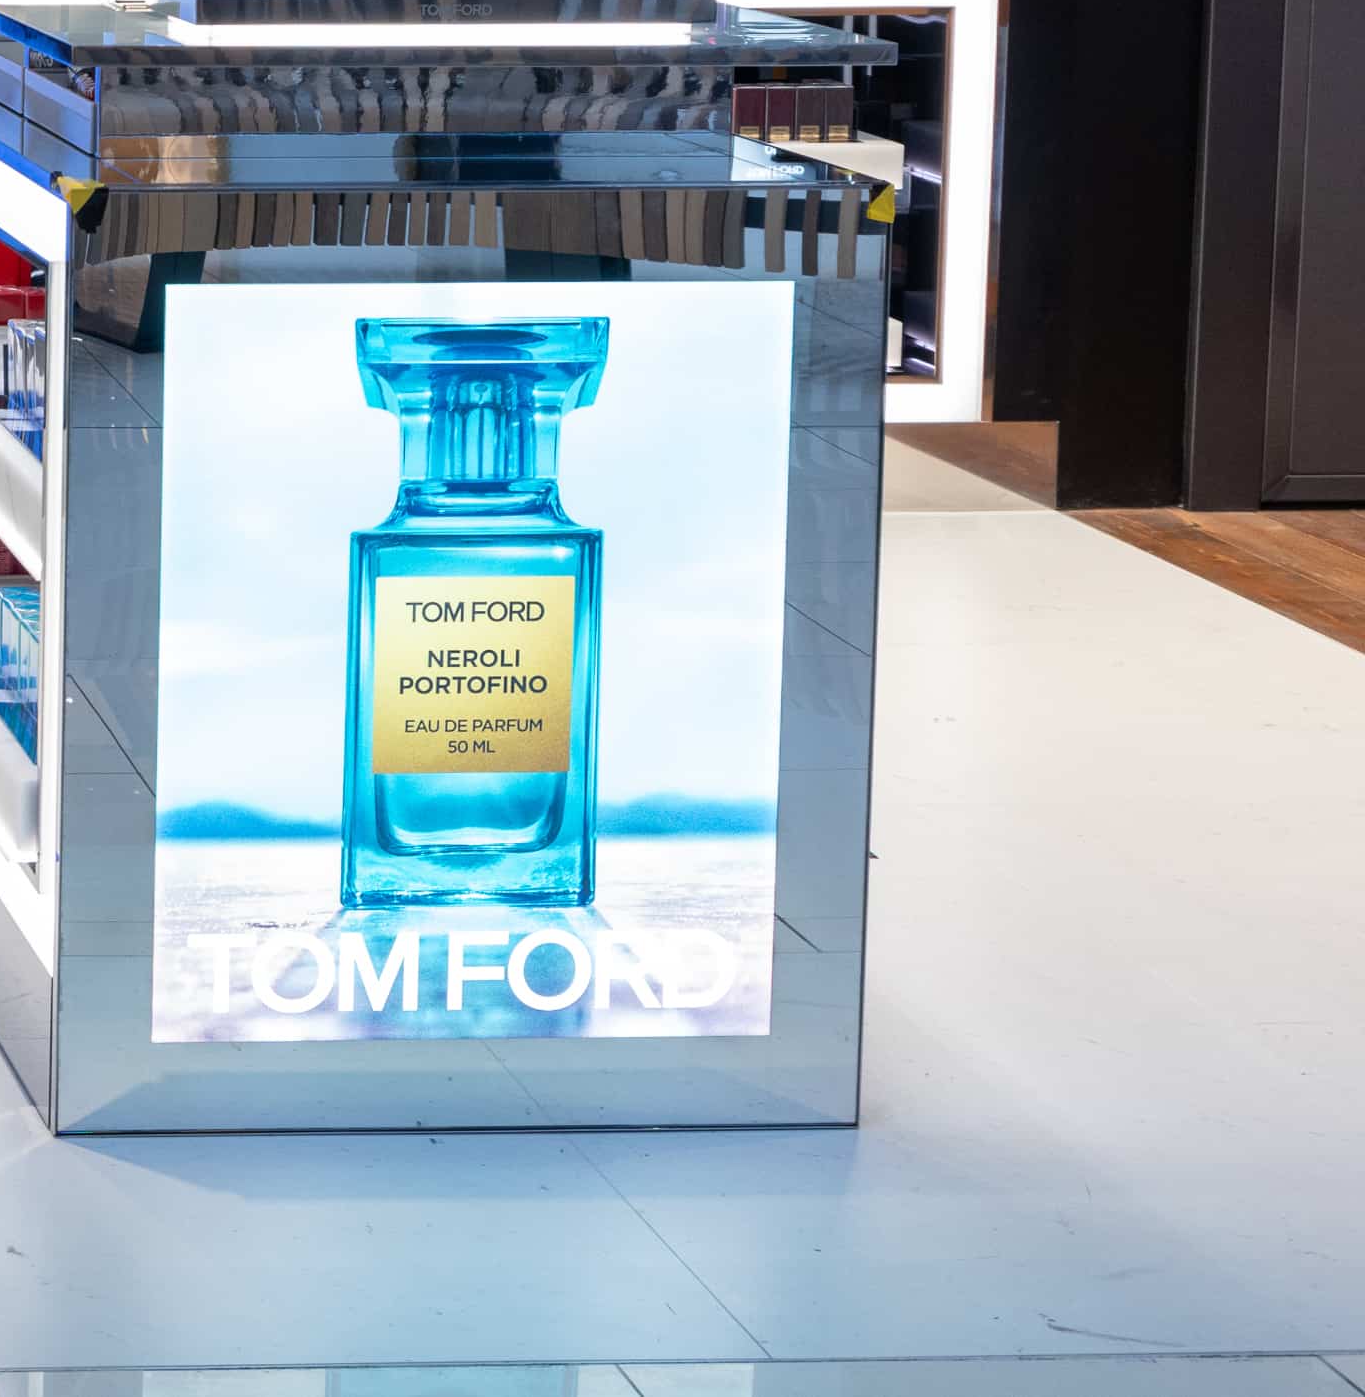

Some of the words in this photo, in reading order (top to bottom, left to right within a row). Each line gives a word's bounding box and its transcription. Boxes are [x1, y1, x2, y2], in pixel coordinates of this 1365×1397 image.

[453, 3, 492, 17] FORD
[405, 601, 465, 623] TOM
[471, 600, 545, 622] FORD
[427, 649, 521, 668] NEROLI
[399, 675, 548, 695] PORTOFINO
[404, 719, 440, 733] EAU
[444, 719, 468, 733] DE
[472, 718, 543, 732] PARFUM
[447, 740, 469, 754] 50
[472, 739, 496, 753] ML
[187, 931, 420, 1014] TOM
[447, 928, 737, 1012] FORD
